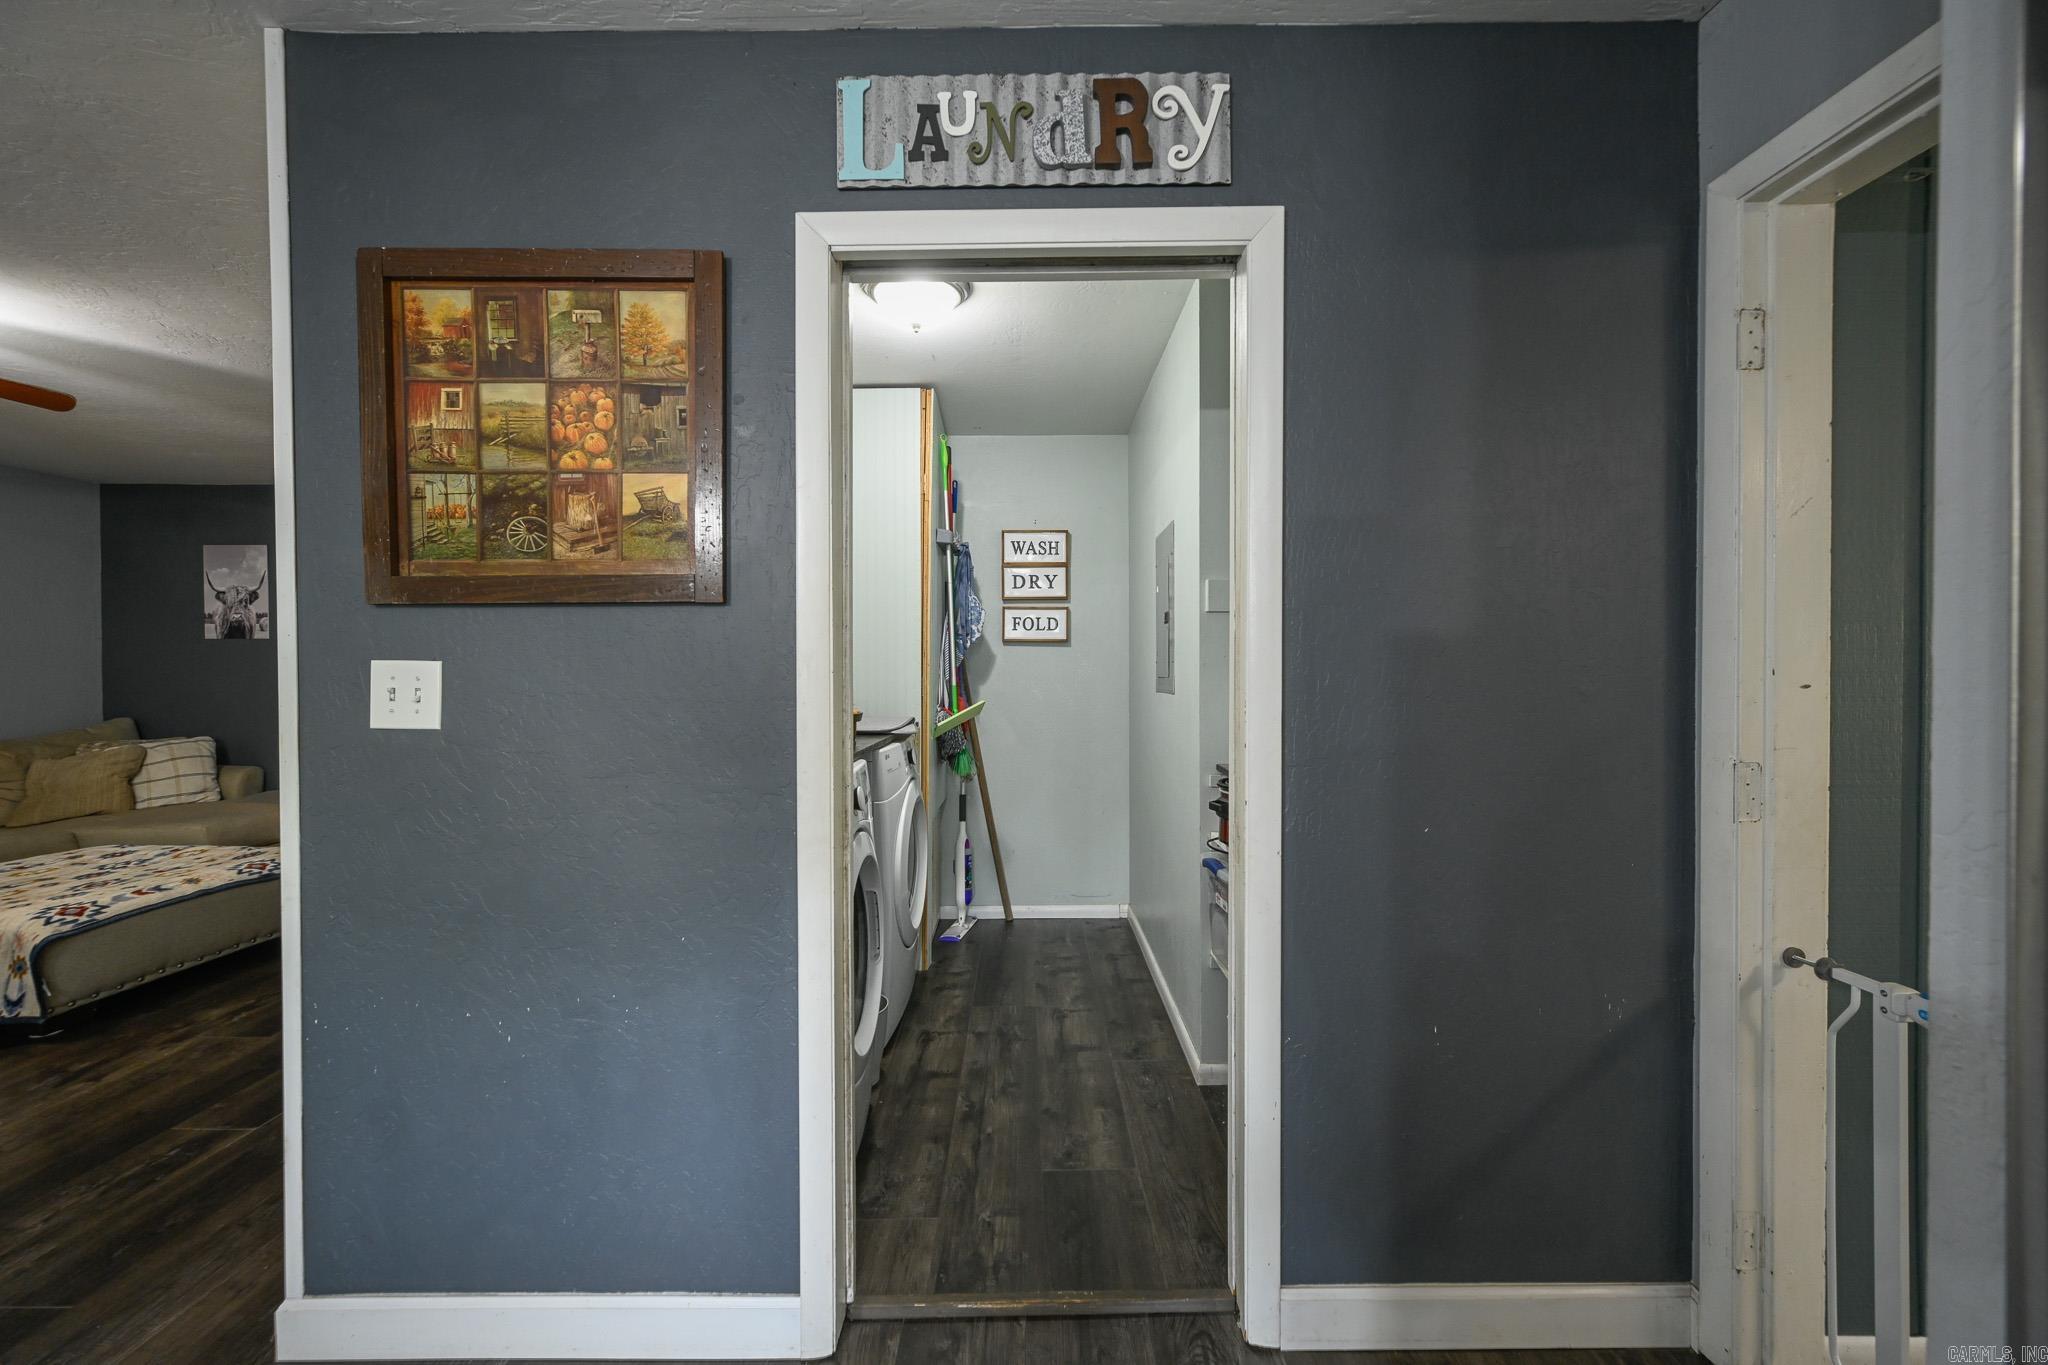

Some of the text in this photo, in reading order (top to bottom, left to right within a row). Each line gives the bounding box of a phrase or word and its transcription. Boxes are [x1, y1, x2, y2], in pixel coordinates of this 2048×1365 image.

[1010, 540, 1060, 555] WASH
[1011, 574, 1058, 589] DRY
[1011, 616, 1059, 631] FOLD
